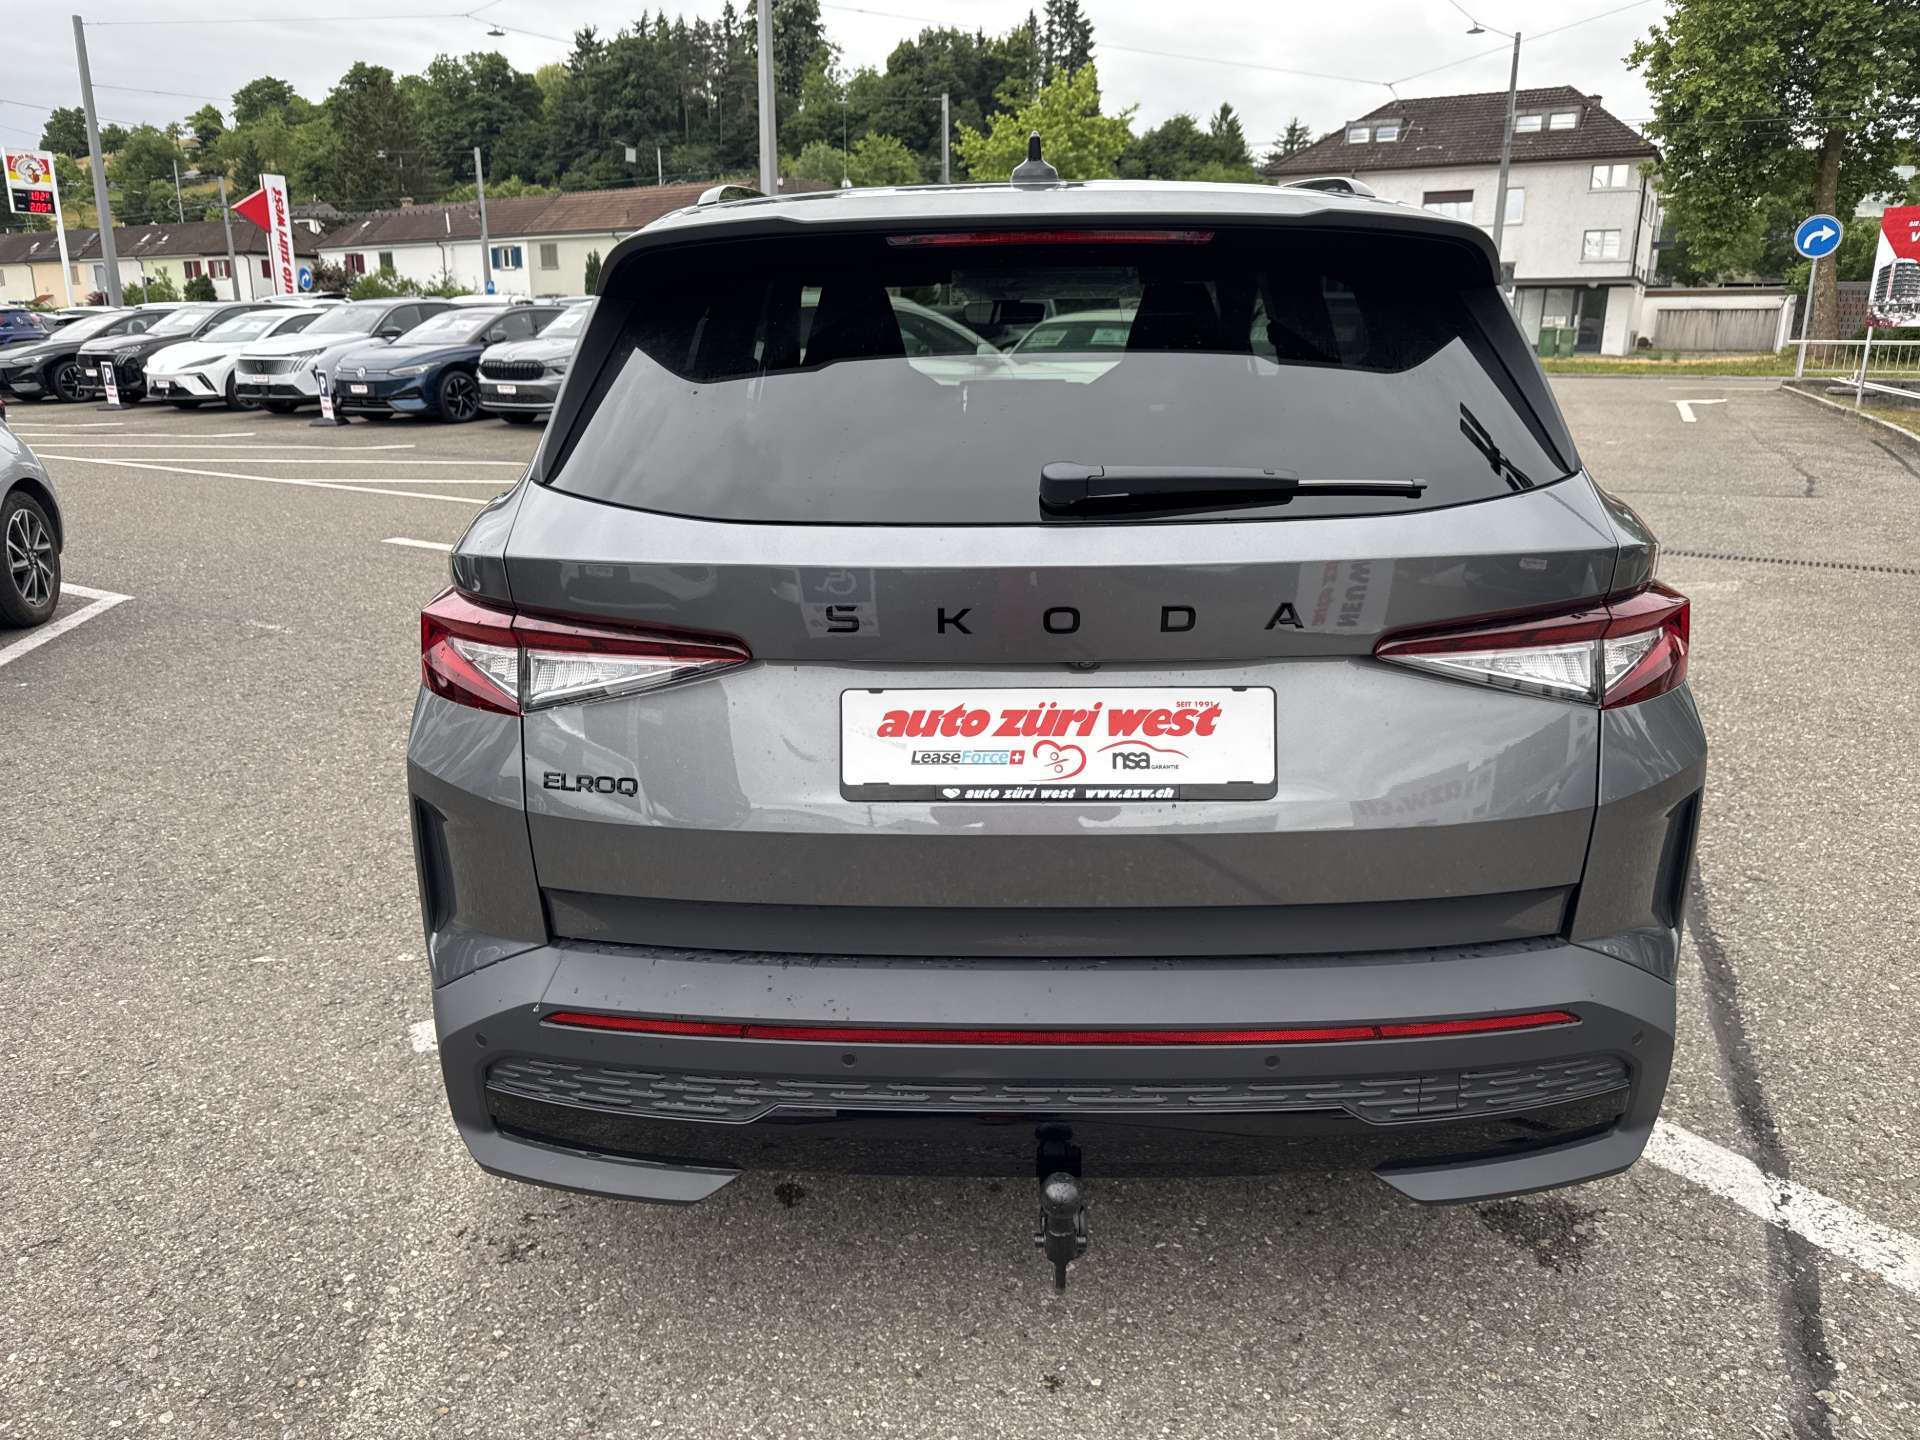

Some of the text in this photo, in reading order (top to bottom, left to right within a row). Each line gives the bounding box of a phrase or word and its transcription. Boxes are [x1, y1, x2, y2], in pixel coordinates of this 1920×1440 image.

[272, 186, 286, 227] west
[283, 266, 294, 294] uto
[104, 367, 112, 384] P
[319, 375, 326, 394] P
[825, 602, 1304, 634] SKODA
[876, 701, 1222, 738] auto züri west
[911, 750, 1009, 765] LeaseForce
[1112, 751, 1150, 770] nsa
[543, 771, 638, 797] ELROQ
[965, 786, 1174, 799] auto züri west www.azw.ch
